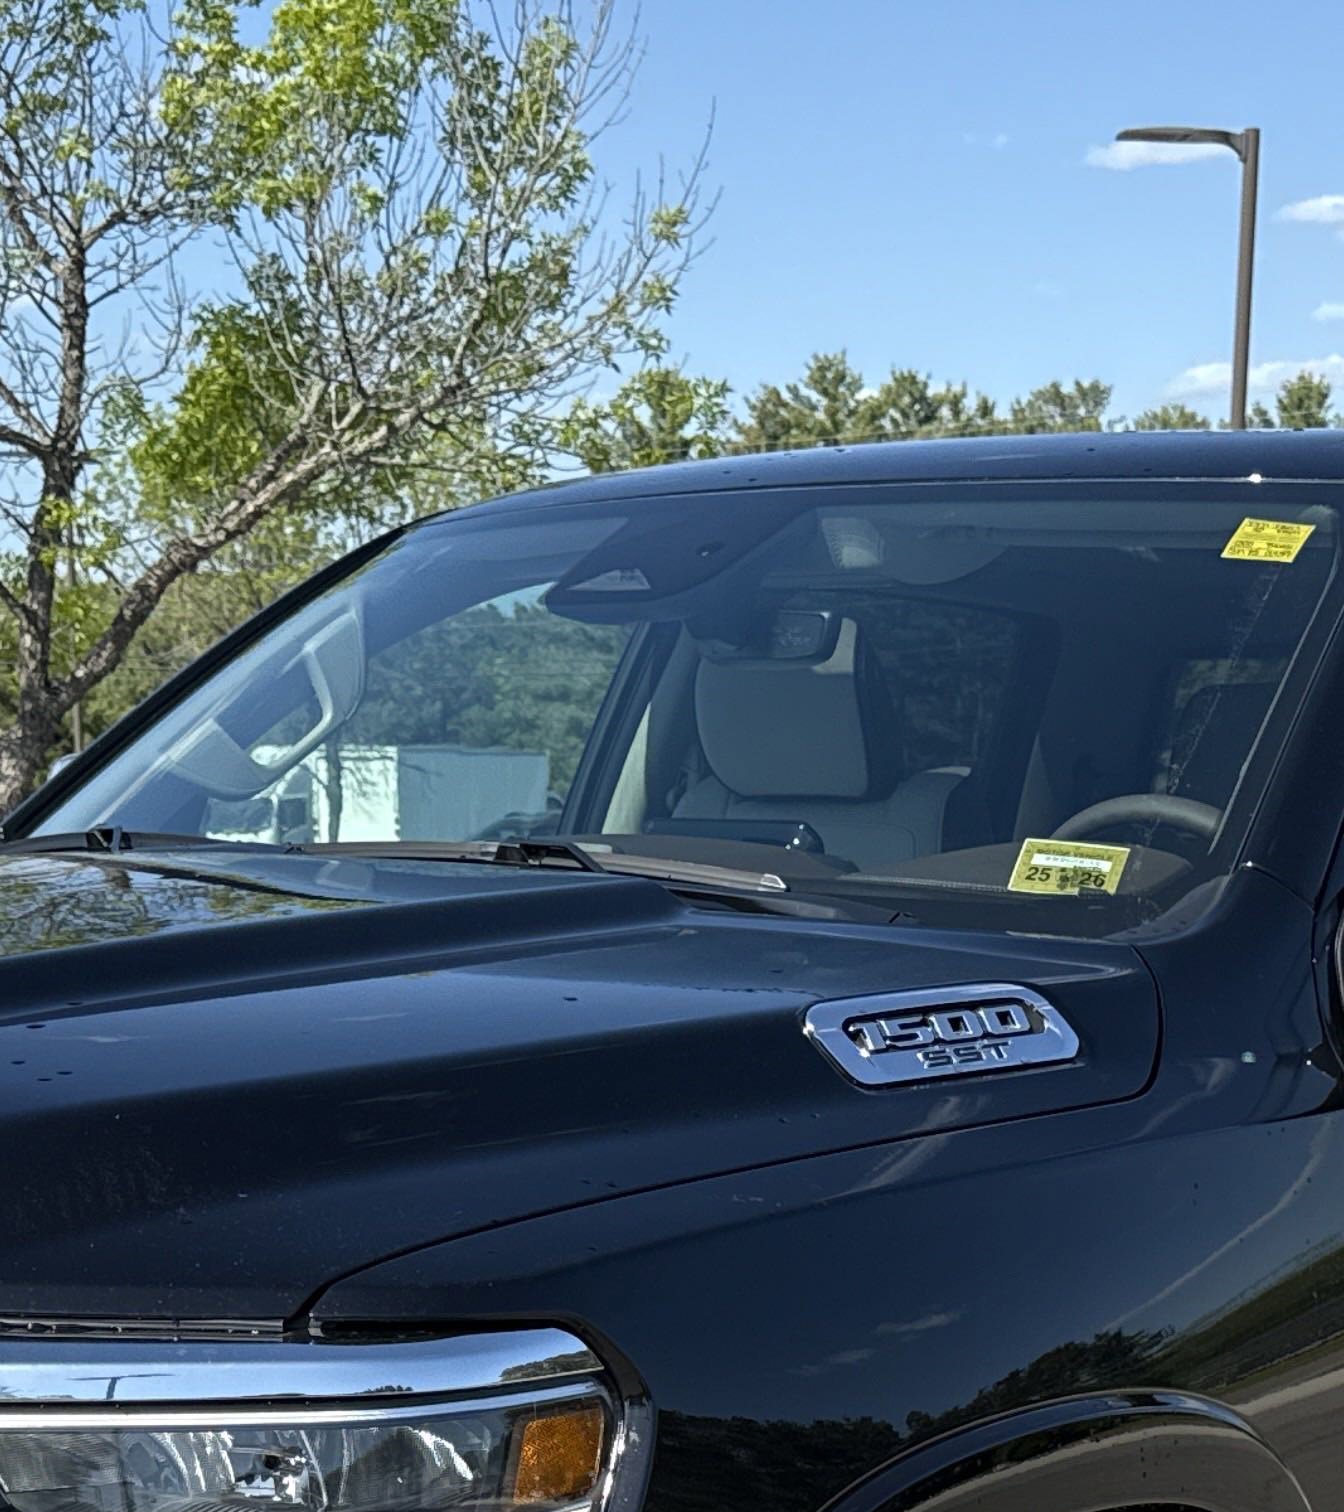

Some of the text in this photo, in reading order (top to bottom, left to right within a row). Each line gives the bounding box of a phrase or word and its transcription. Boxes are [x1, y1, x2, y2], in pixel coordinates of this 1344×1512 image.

[1024, 865, 1053, 883] 25
[1079, 871, 1108, 888] 26
[849, 1004, 1031, 1050] 1500
[916, 1039, 1013, 1070] SST
